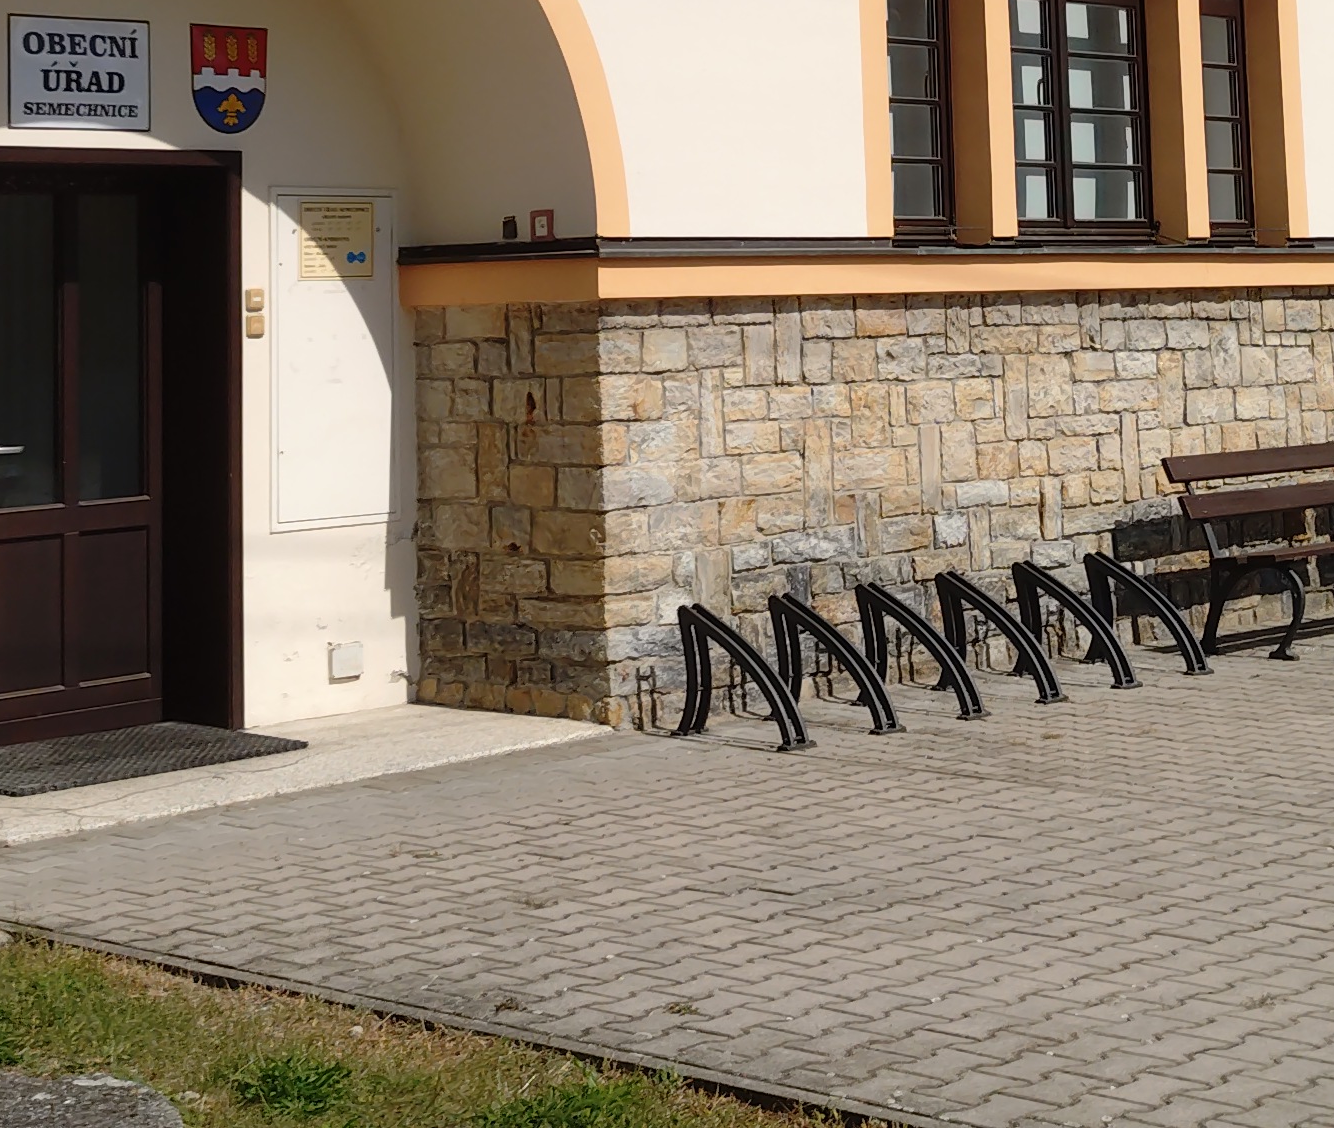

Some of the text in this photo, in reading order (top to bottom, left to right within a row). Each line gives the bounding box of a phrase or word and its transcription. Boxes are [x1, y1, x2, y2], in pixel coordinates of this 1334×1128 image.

[22, 29, 139, 59] OBECNÍ
[40, 61, 126, 93] ÚŘAD
[23, 102, 139, 118] SEMECHNICE
